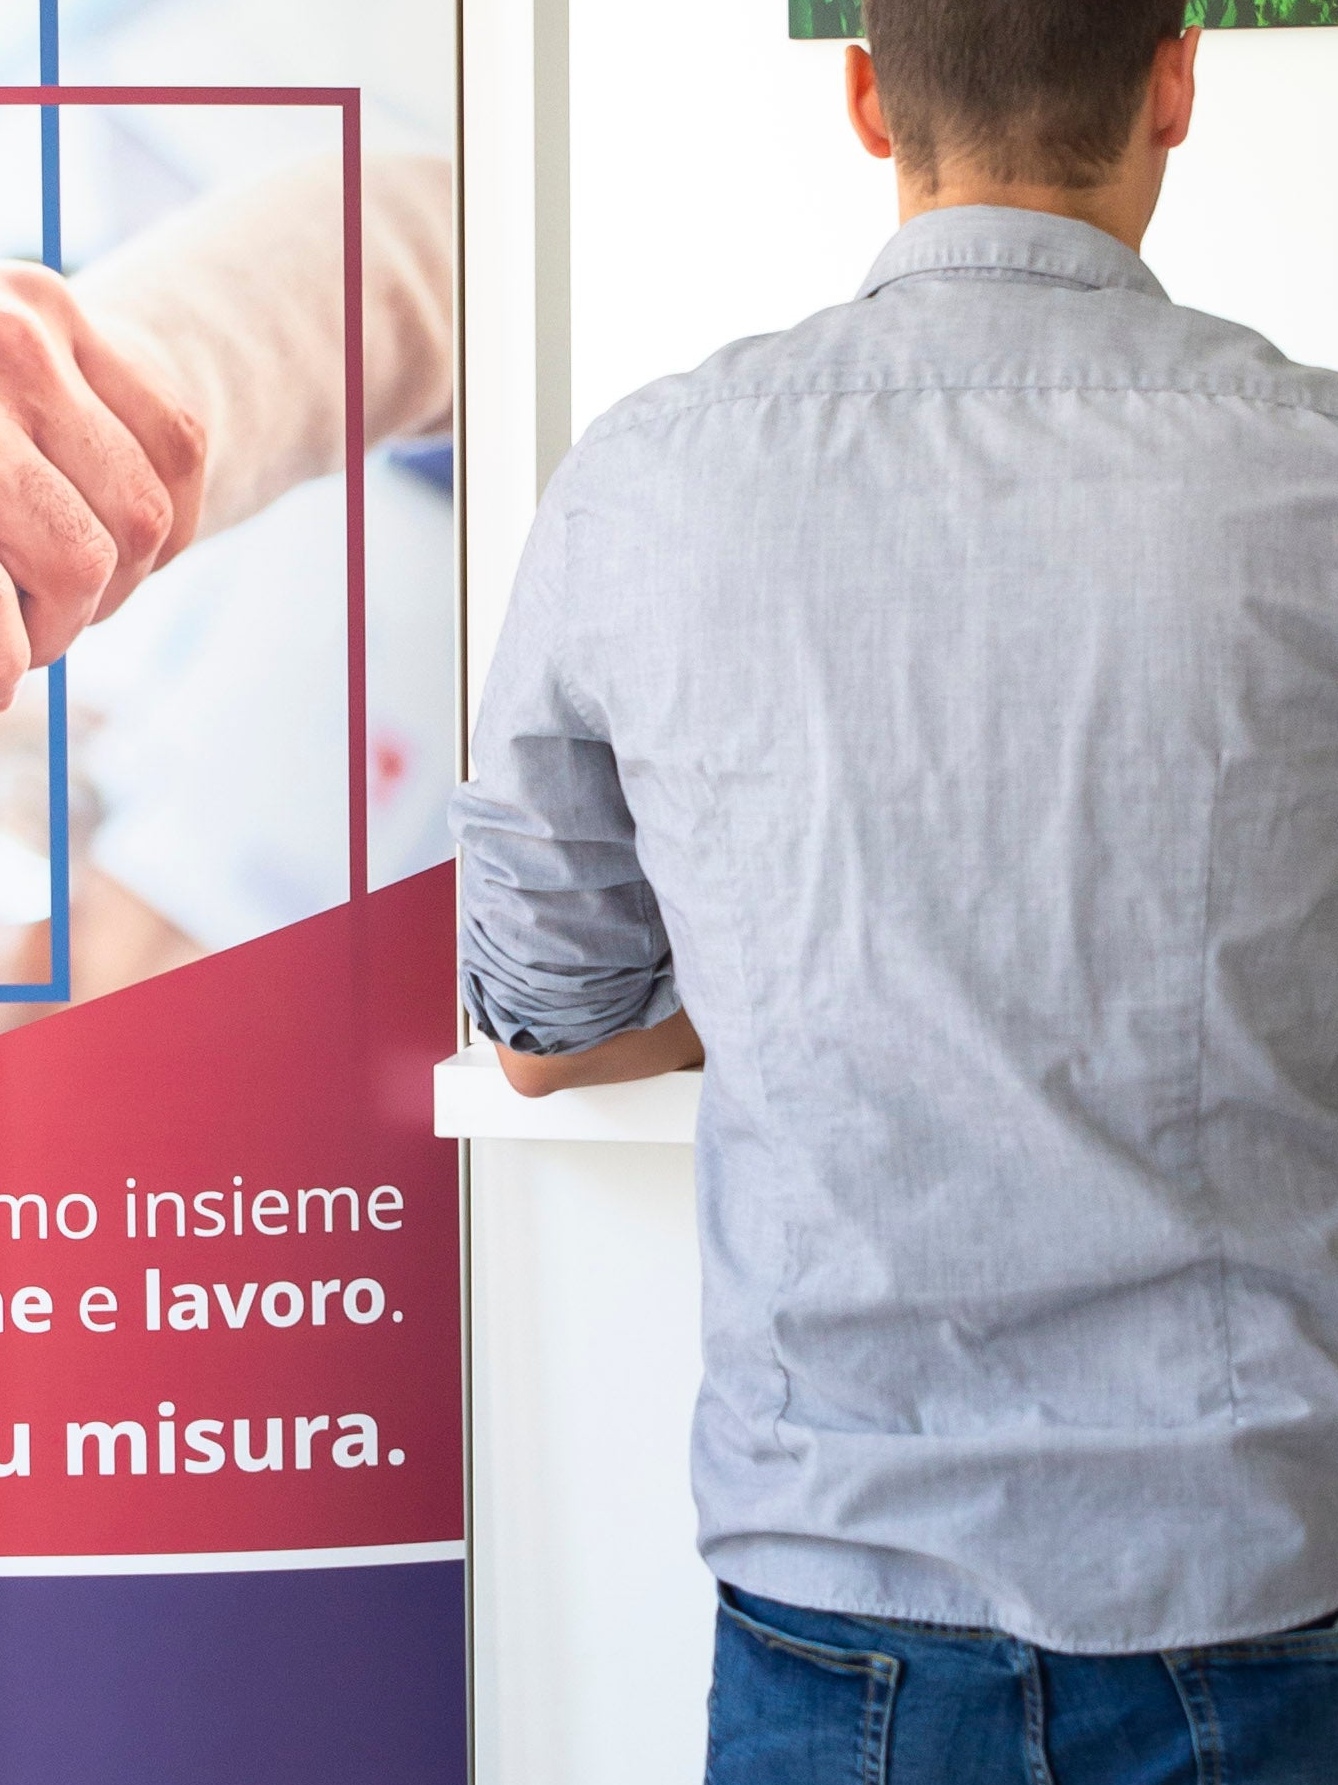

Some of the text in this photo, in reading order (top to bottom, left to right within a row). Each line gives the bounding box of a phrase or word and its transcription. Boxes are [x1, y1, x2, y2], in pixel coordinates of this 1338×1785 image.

[125, 1175, 405, 1238] insieme
[79, 1286, 118, 1333] e
[145, 1268, 404, 1331] lavoro.
[65, 1401, 407, 1476] misura.
